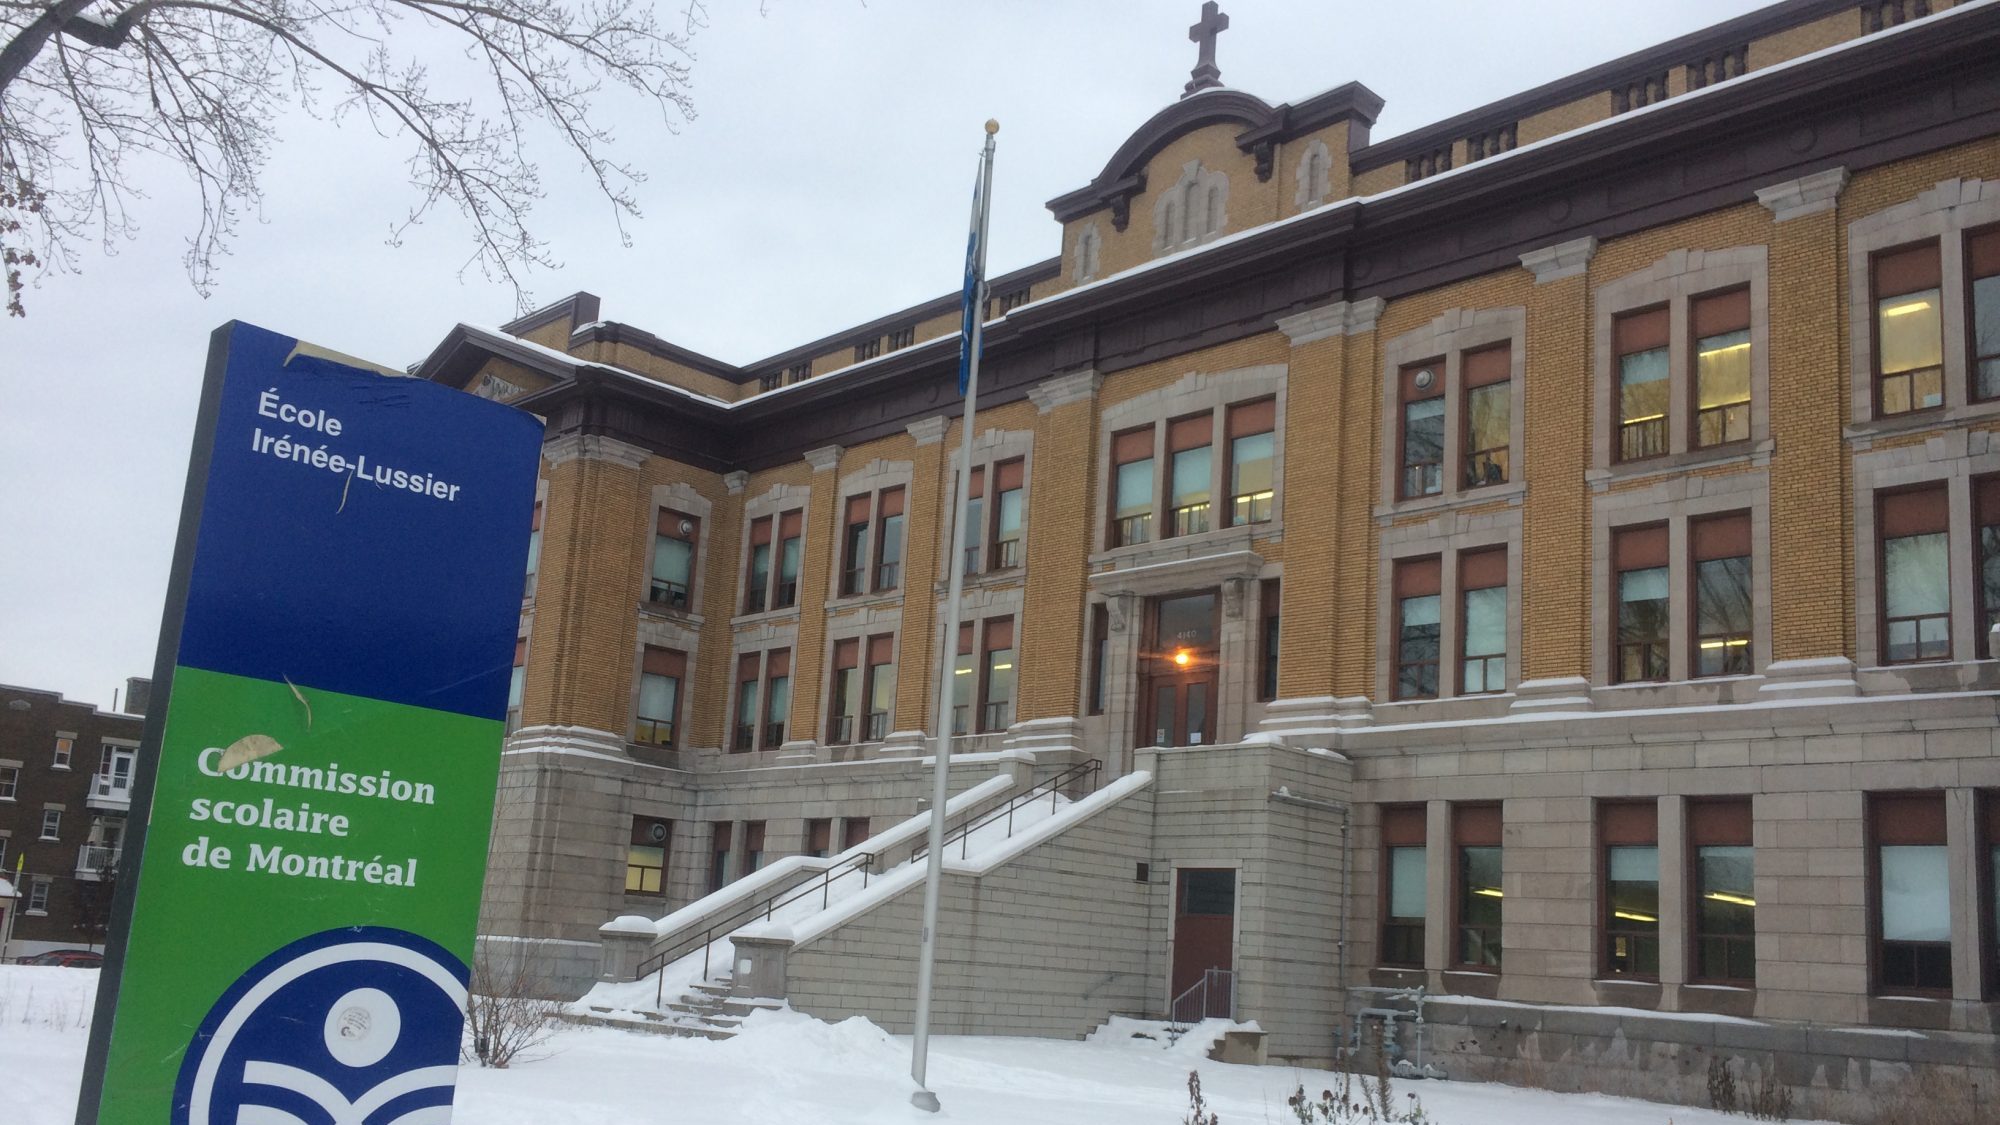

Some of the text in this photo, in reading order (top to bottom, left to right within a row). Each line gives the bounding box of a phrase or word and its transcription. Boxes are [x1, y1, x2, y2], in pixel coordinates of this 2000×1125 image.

[258, 388, 342, 436] École
[252, 427, 460, 501] Irénée-Lussier
[197, 747, 435, 804] Commission
[189, 798, 349, 836] scolaire
[182, 836, 417, 887] de Montréal
